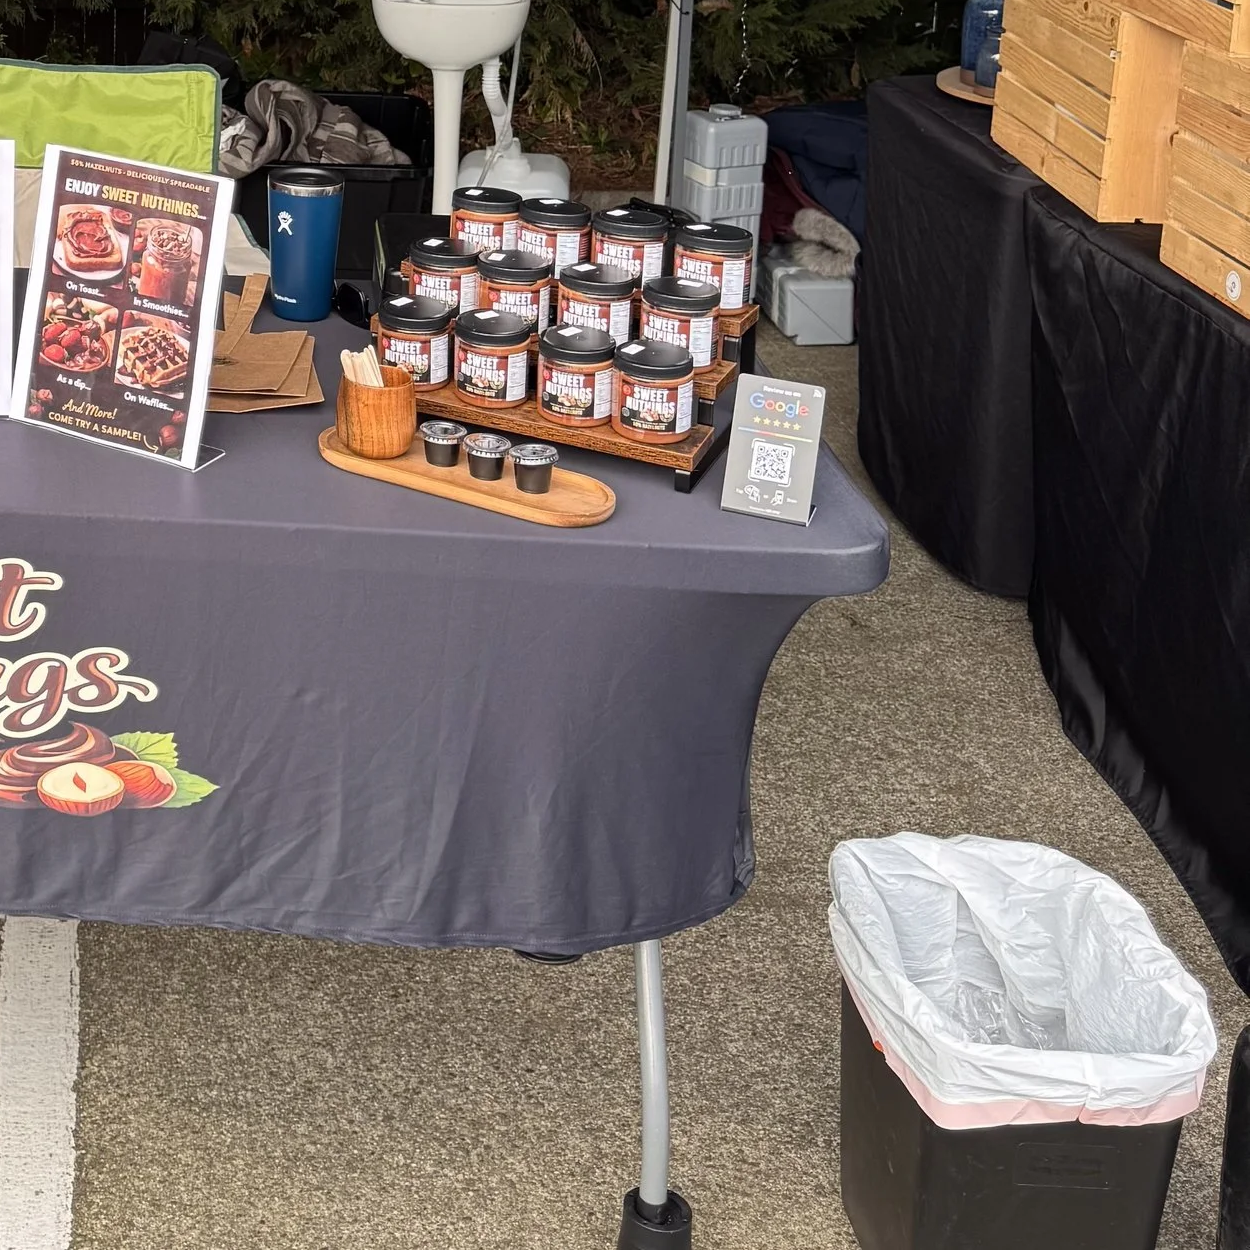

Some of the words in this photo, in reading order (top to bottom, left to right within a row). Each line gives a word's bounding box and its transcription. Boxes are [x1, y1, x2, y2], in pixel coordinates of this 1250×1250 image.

[70, 159, 84, 168] 50%
[85, 161, 123, 175] HAZELNUTS
[127, 170, 170, 184] DELICIOUSLY
[170, 179, 210, 193] SPREADABLE
[65, 178, 101, 197] ENJOY
[101, 185, 140, 205] SWEET
[463, 220, 495, 236] SWEET
[521, 230, 548, 247] SWEET
[603, 243, 634, 259] SWEET
[682, 258, 713, 275] SWEET
[66, 281, 77, 290] On
[421, 273, 451, 290] SWEET
[133, 297, 141, 306] In
[415, 284, 458, 304] NUTHINGS
[500, 290, 533, 305] SWEET
[569, 301, 600, 318] SWEET
[649, 315, 680, 333] SWEET
[643, 326, 687, 348] NUTHINGS
[390, 339, 422, 354] SWEET
[385, 348, 428, 367] NUTHINGS
[467, 351, 499, 370] SWEET
[56, 374, 67, 384] As
[461, 361, 505, 381] NUTHINGS
[551, 369, 585, 388] SWEET
[124, 391, 136, 402] On
[545, 381, 592, 401] NUTHINGS
[634, 385, 669, 402] SWEET
[62, 399, 85, 414] And
[85, 403, 117, 420] More!
[626, 396, 675, 415] NUTHINGS
[750, 392, 809, 418] Google
[49, 412, 73, 425] COME
[75, 418, 91, 429] TRY
[93, 424, 99, 432] A
[101, 425, 141, 441] SAMPLE!
